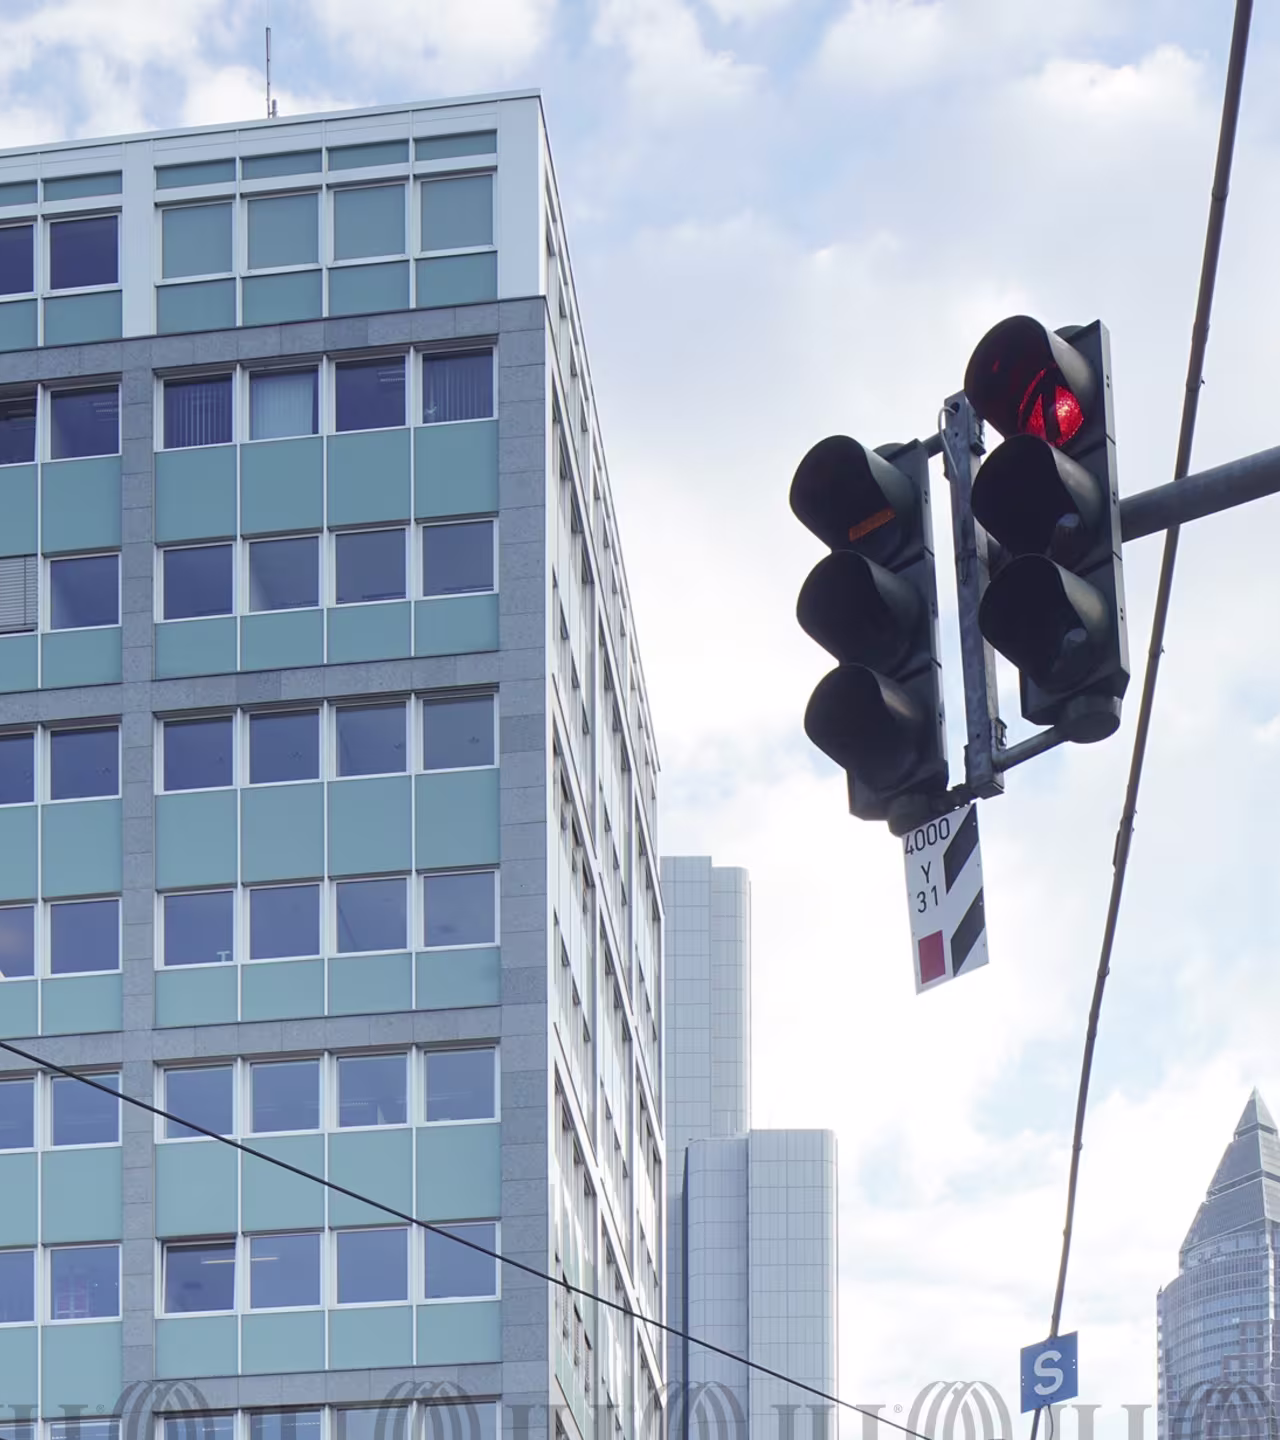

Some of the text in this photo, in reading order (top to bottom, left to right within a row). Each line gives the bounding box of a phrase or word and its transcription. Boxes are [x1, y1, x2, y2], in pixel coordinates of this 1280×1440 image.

[904, 817, 950, 856] 4000
[921, 861, 932, 884] Y
[916, 886, 940, 913] 31
[1033, 1350, 1064, 1396] S
